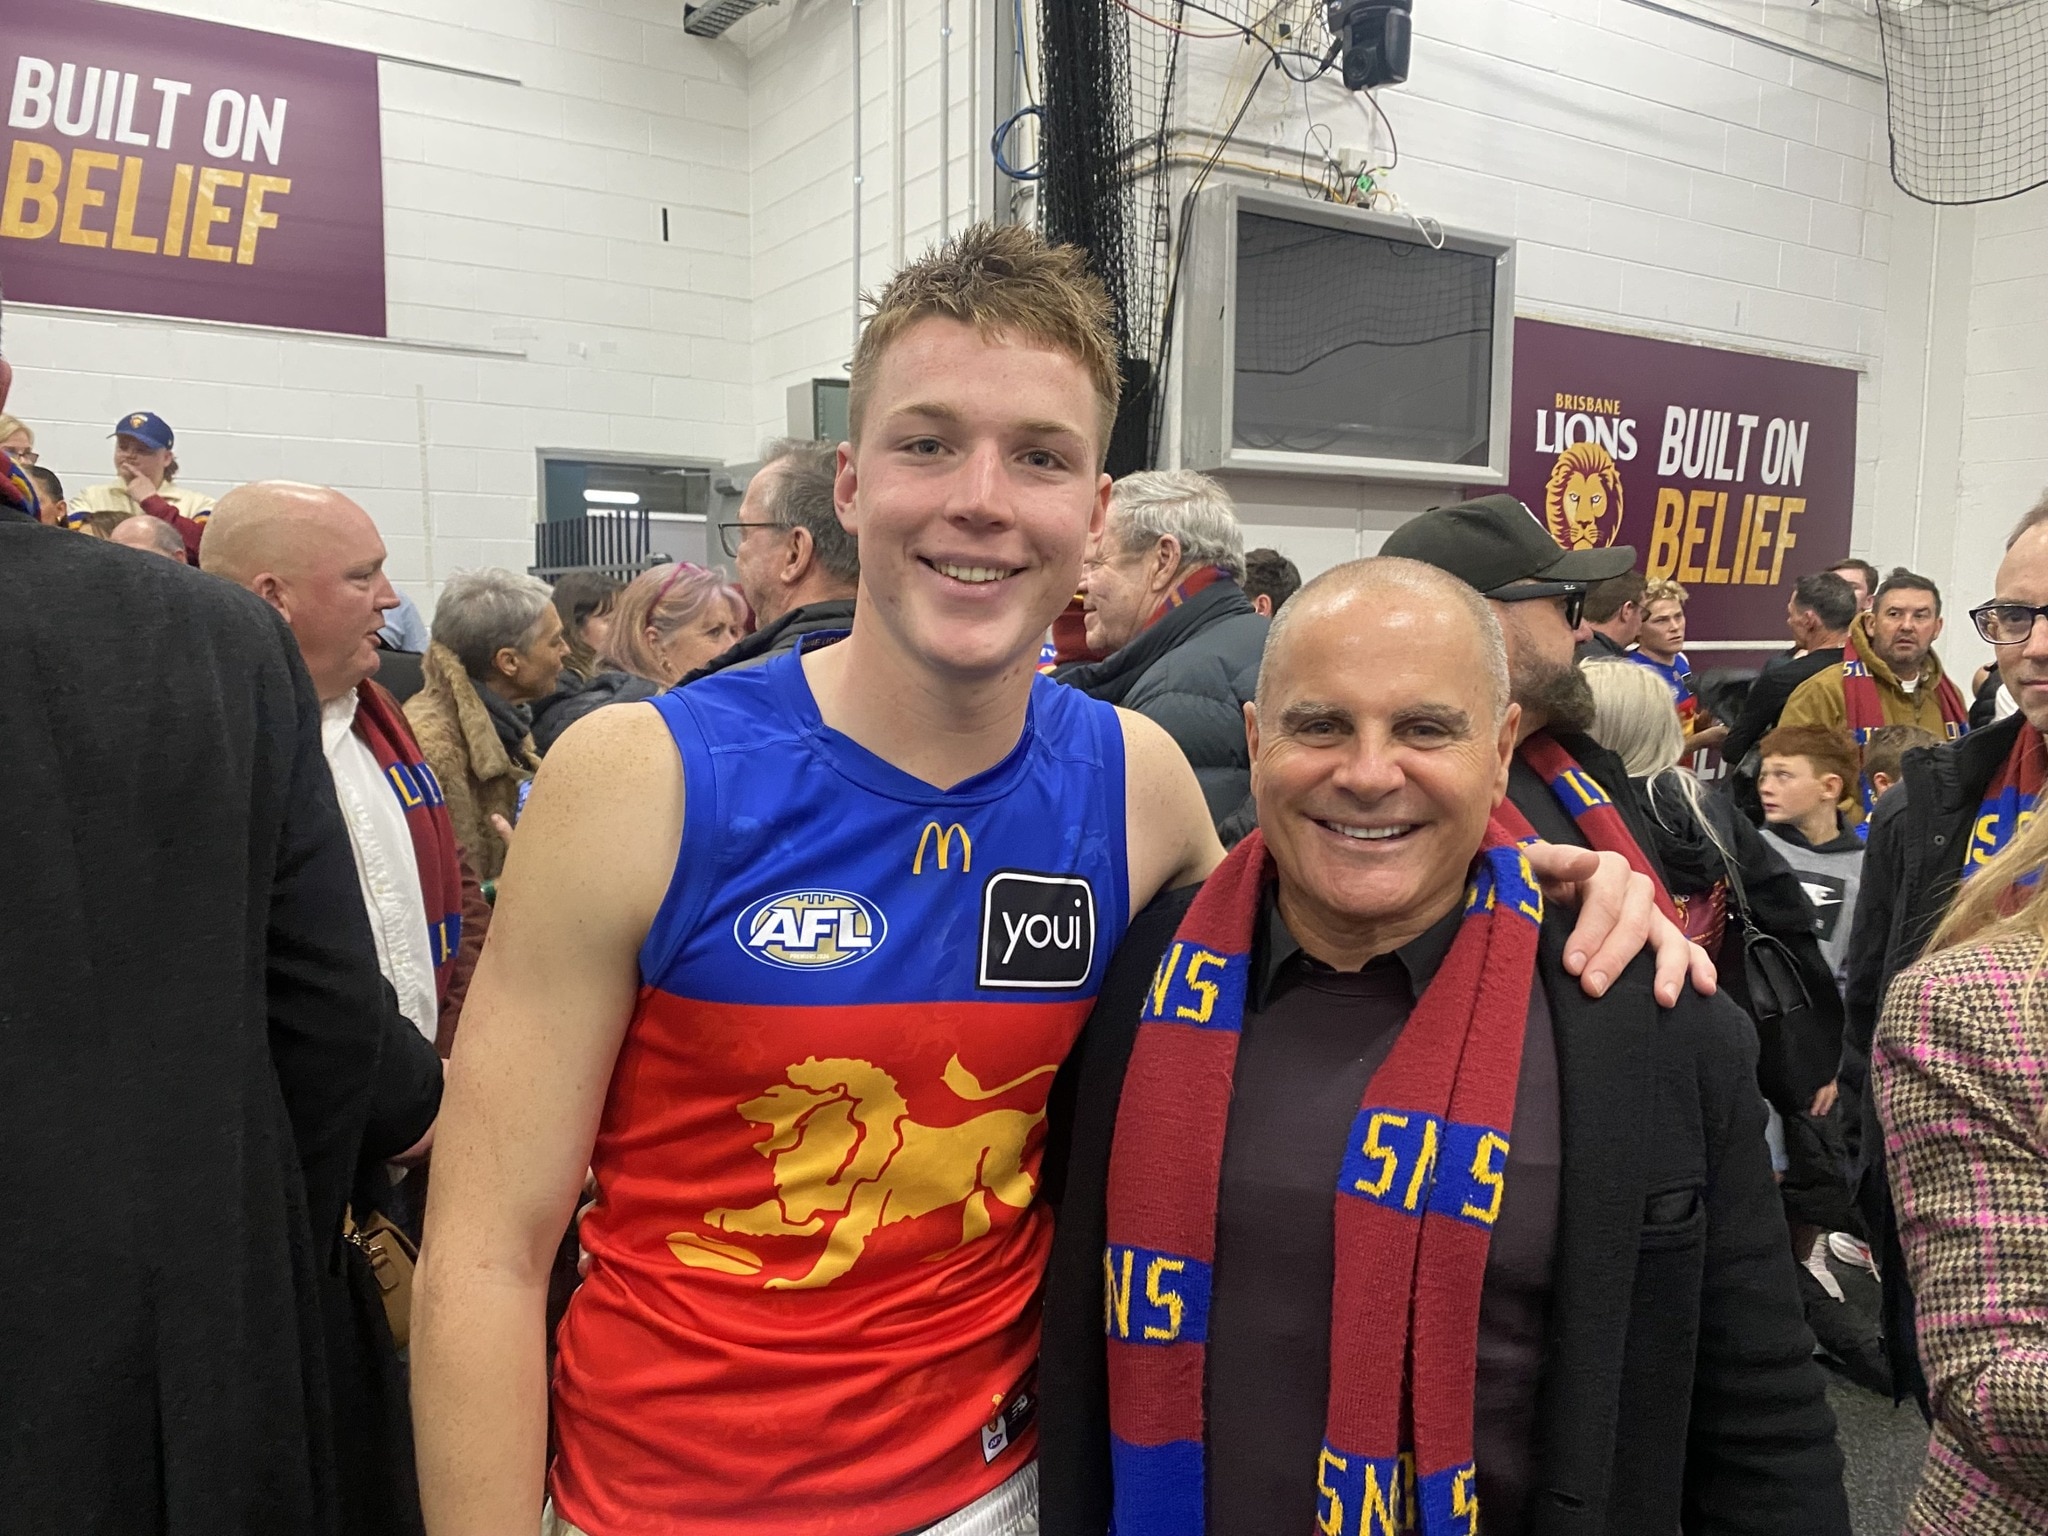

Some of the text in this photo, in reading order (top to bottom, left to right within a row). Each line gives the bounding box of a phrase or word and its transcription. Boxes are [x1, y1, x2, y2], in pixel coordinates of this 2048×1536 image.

[8, 56, 287, 165] BUILT ON
[0, 140, 291, 265] BELIEF
[1535, 409, 1638, 461] LIONS
[1555, 392, 1621, 415] BRISBANE
[1657, 405, 1809, 487] BUILT ON
[1645, 487, 1807, 585] BELIEF
[748, 909, 872, 947] AFL
[1001, 898, 1082, 965] youi
